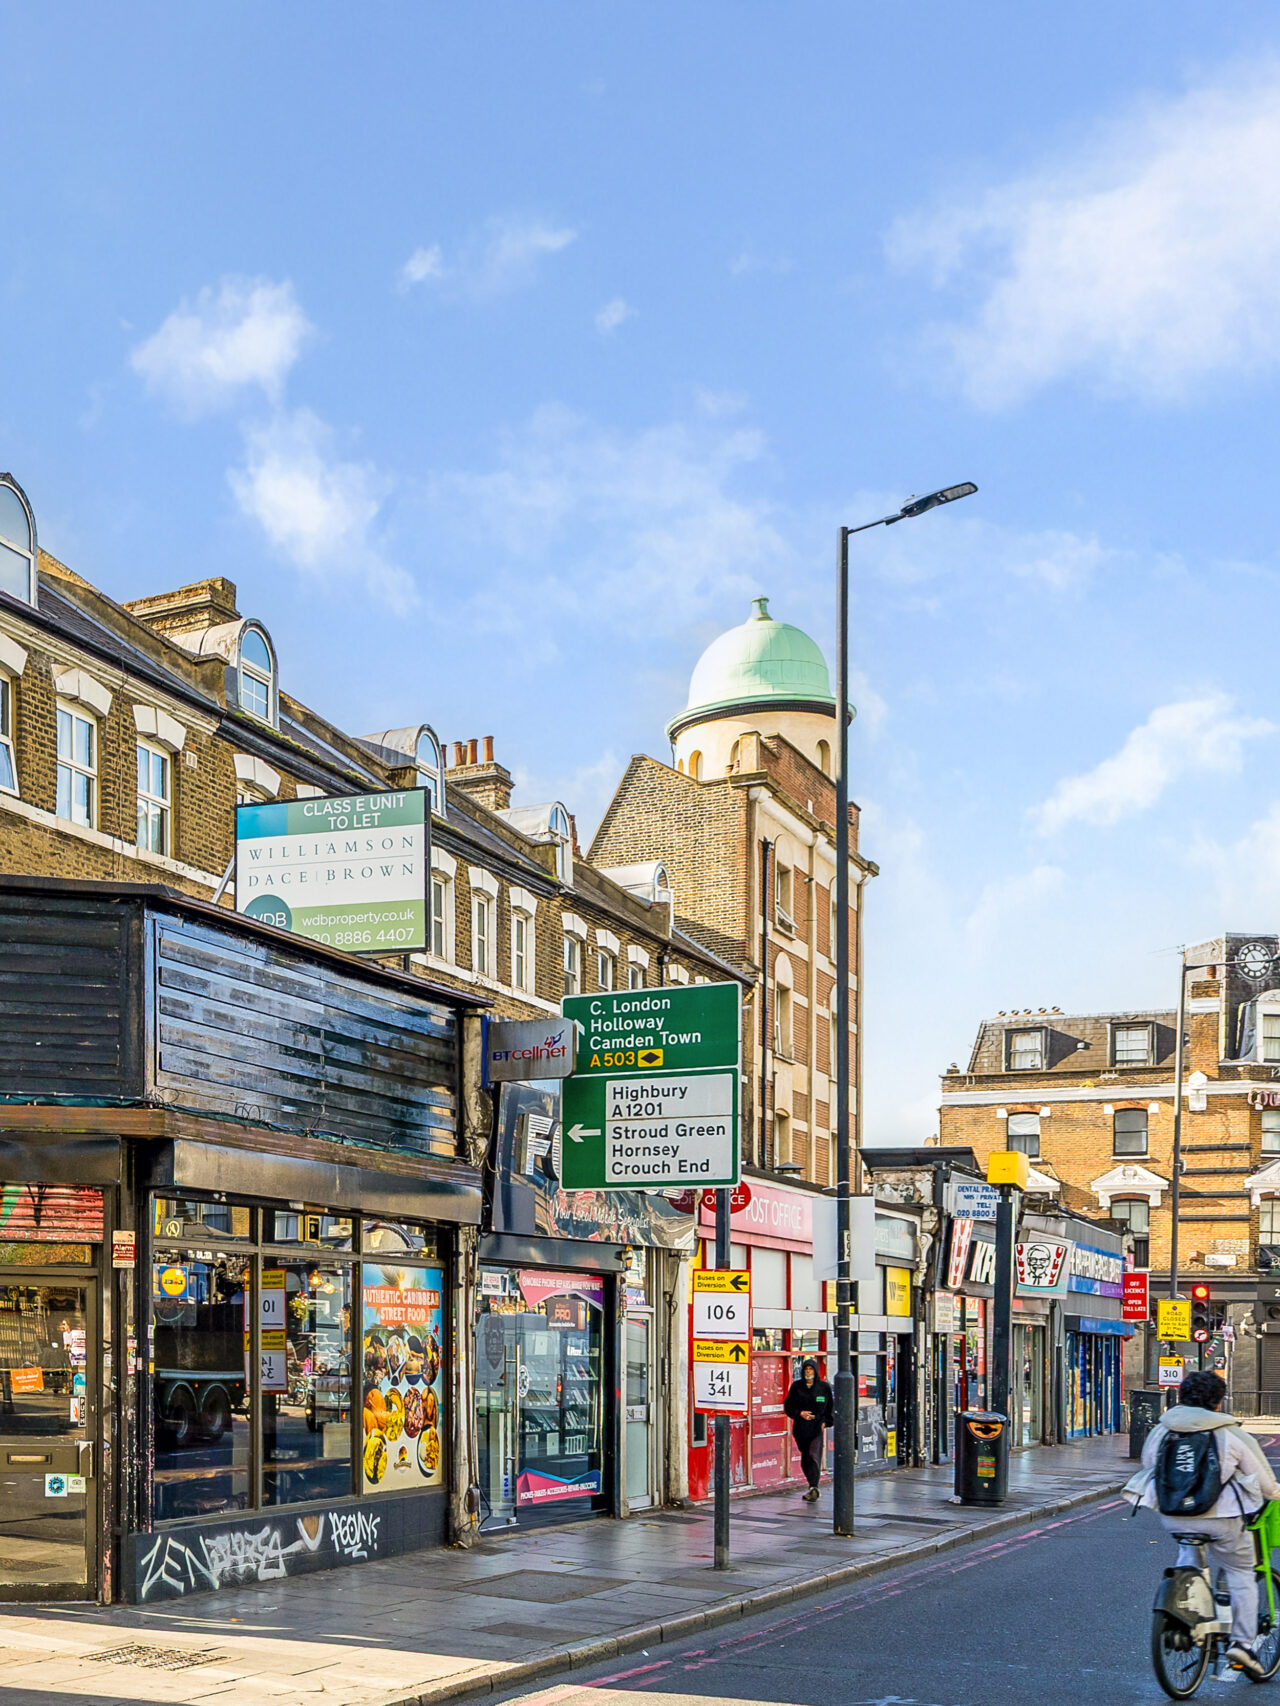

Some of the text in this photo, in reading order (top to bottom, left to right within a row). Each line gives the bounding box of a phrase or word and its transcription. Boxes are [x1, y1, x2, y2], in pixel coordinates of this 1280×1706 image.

[303, 794, 407, 817] CLASS E UNIT
[328, 812, 381, 830] TO LET
[249, 836, 414, 861] WILLIAMSON
[248, 863, 414, 887] DACE BROWN
[302, 909, 415, 928] wdbproperty.co.uk
[334, 930, 372, 945] 8886
[376, 928, 415, 943] 4407
[590, 997, 671, 1016] C. London
[590, 1016, 664, 1033] Holloway
[590, 1031, 702, 1050] Camden Town
[612, 1085, 688, 1102] Highbury
[612, 1102, 662, 1118] A1201
[612, 1123, 726, 1140] Stroud Green
[612, 1143, 680, 1158] Hornsey
[612, 1159, 710, 1176] Crouch End
[555, 1204, 650, 1228] Your Local Mobile Specialist
[745, 1196, 802, 1230] POST OFFICE
[1016, 1244, 1025, 1282] KFC
[1048, 1247, 1064, 1285] KFC
[363, 1288, 439, 1306] AUTHENTIC CARIBBEAN
[380, 1307, 426, 1321] STREET FOOD
[555, 1309, 570, 1320] PRO
[707, 1305, 736, 1320] 106
[710, 1370, 730, 1382] 141
[708, 1383, 731, 1397] 341
